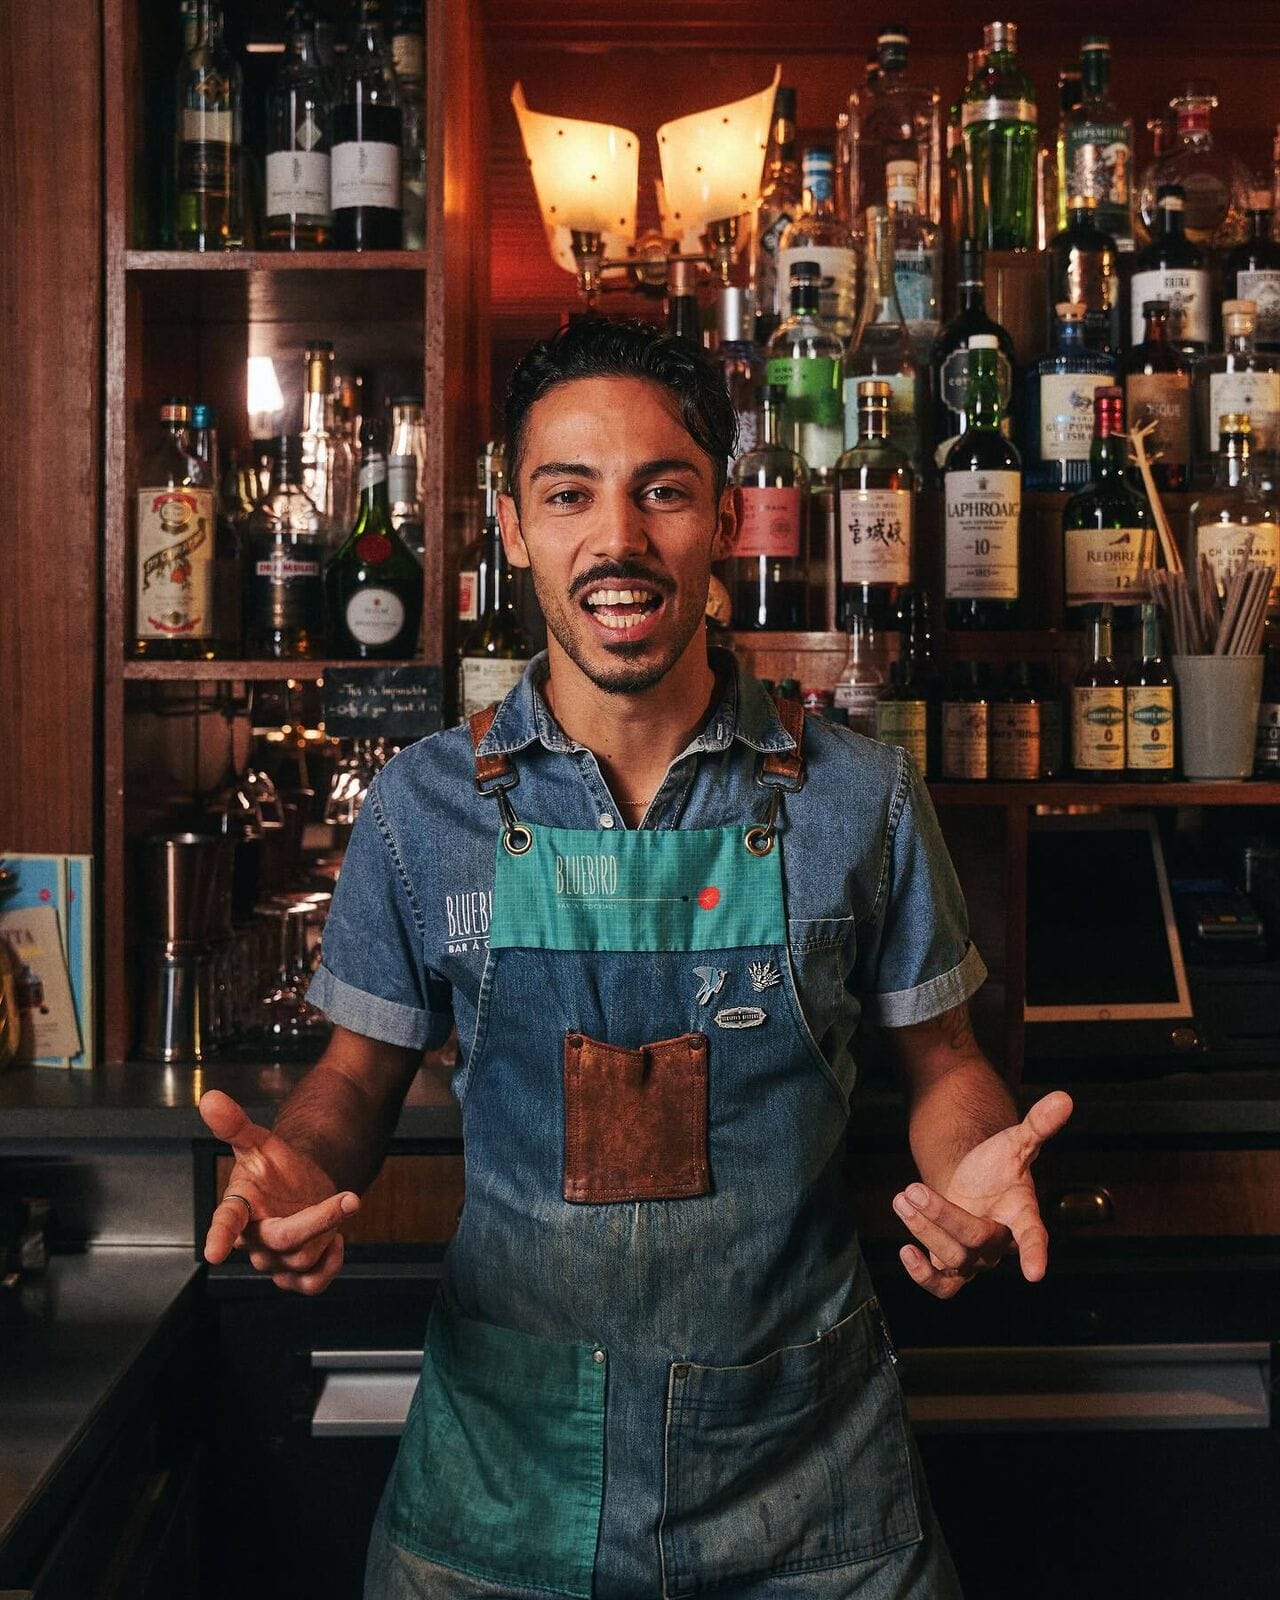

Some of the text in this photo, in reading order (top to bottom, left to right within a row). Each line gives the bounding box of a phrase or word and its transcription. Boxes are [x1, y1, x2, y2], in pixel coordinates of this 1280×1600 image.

[974, 538, 990, 556] 10
[1087, 550, 1150, 561] REDBRE
[1116, 576, 1131, 588] 12
[556, 854, 618, 896] BLUEBIRD
[446, 890, 492, 937] BLUEBI
[448, 943, 468, 954] BAR
